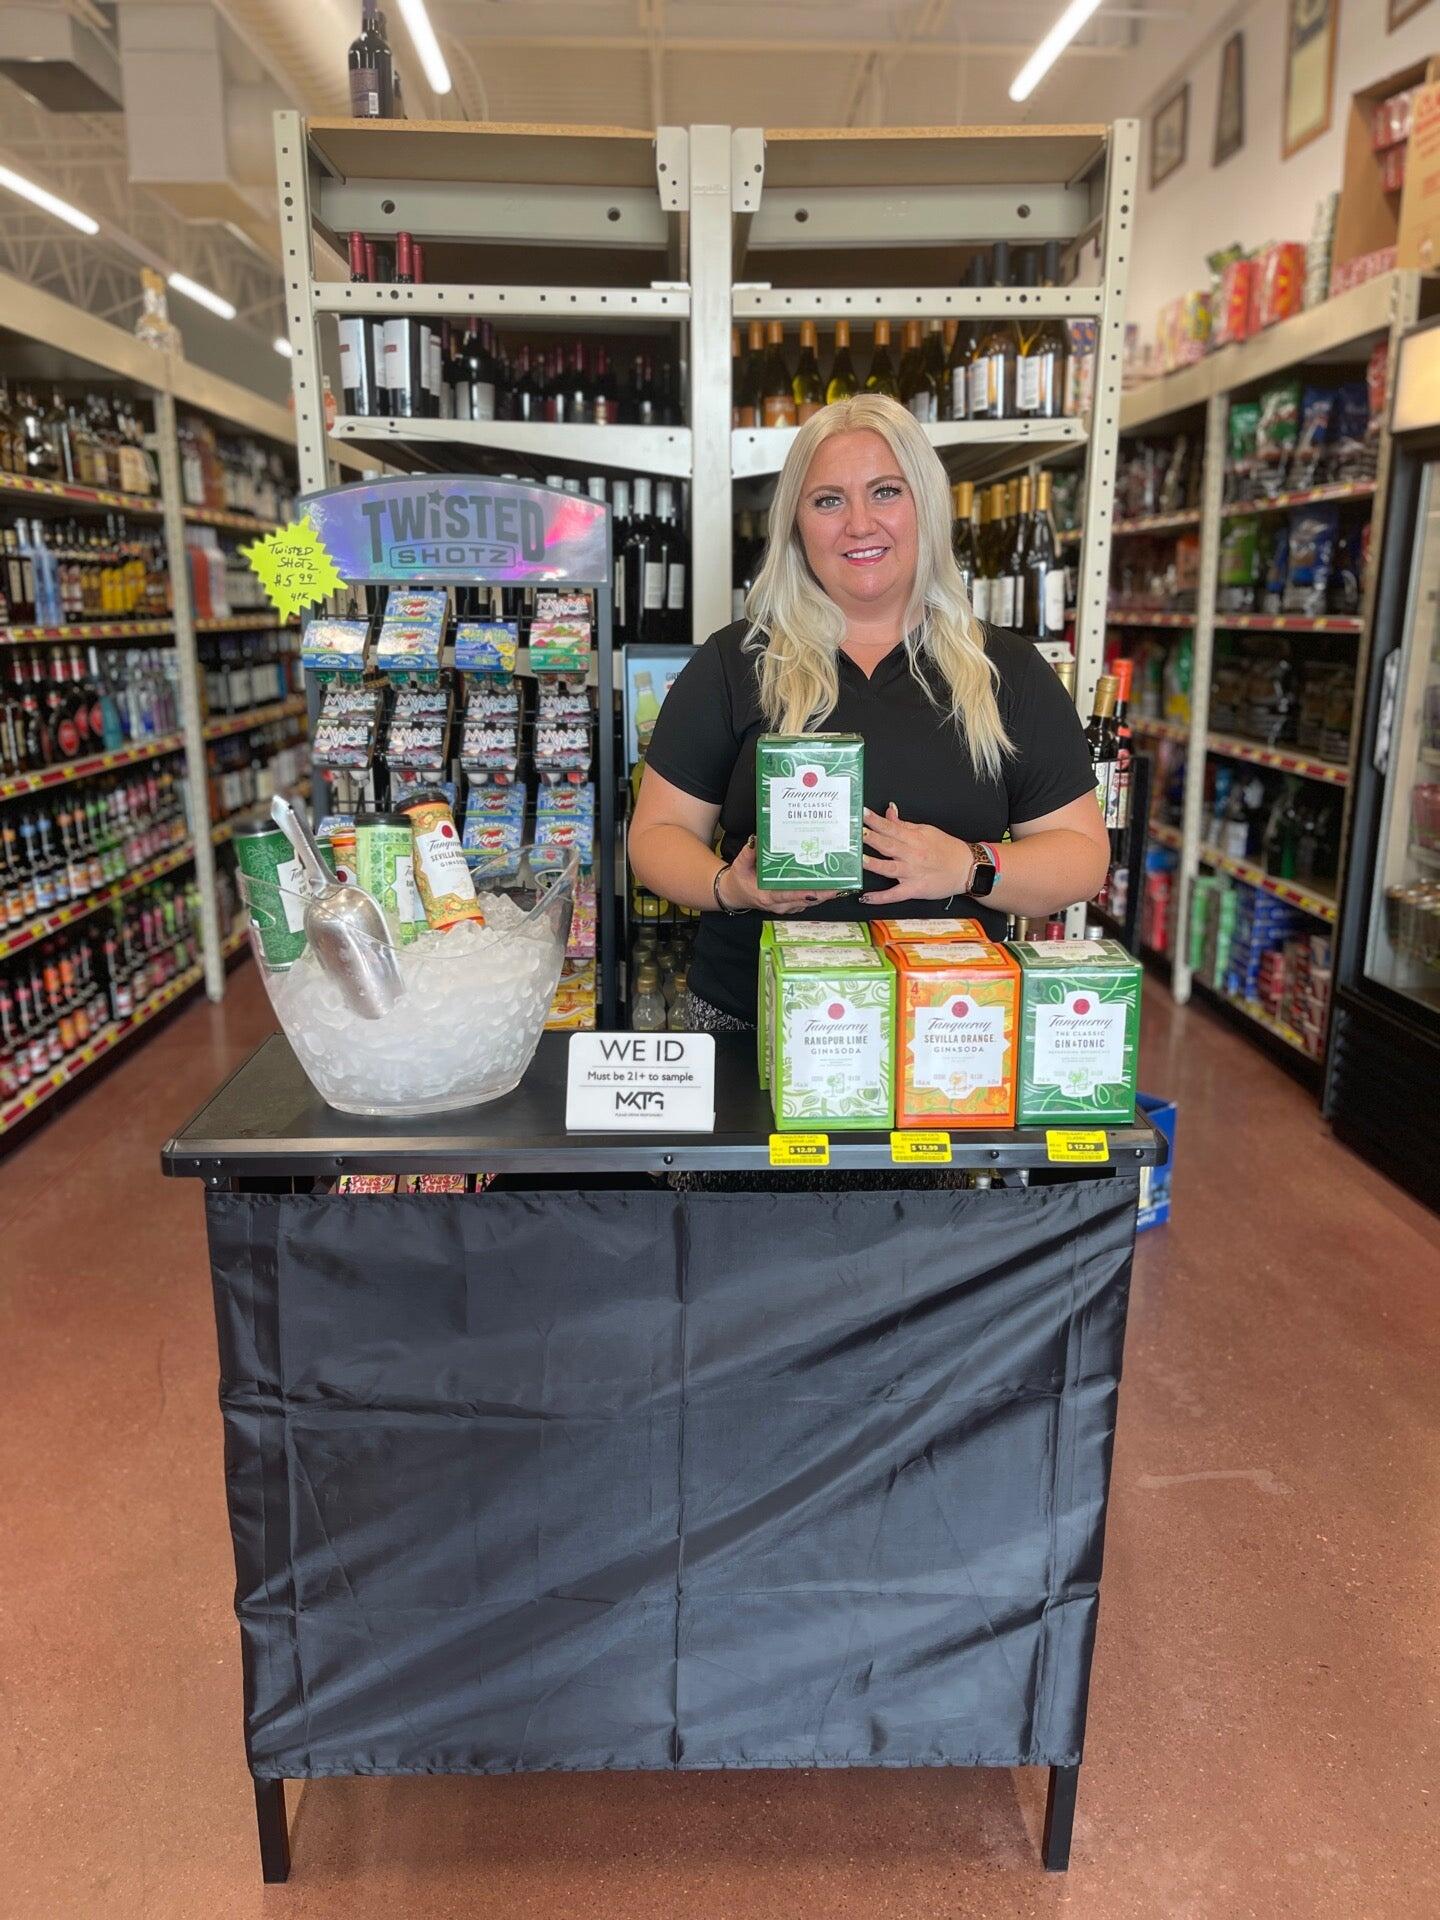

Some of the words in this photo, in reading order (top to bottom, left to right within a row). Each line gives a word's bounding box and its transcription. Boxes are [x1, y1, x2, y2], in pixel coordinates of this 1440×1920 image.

[397, 547, 509, 564] SHOTZ
[782, 787, 839, 801] Tanqueray
[804, 1019, 869, 1034] Tanqueray
[928, 1017, 992, 1032] Tanqueray
[1049, 1014, 1113, 1029] Tanqueray
[804, 1036, 844, 1045] RANGPUR
[847, 1035, 868, 1045] LIME
[924, 1034, 959, 1043] SEVILLA
[961, 1034, 994, 1043] ORANGE
[600, 1039, 646, 1062] WE
[656, 1040, 685, 1062] ID
[587, 1071, 611, 1081] Must
[613, 1072, 625, 1081] be
[627, 1072, 645, 1081] 21+
[648, 1073, 659, 1081] to
[661, 1072, 694, 1083] sample
[615, 1091, 664, 1110] MKTG
